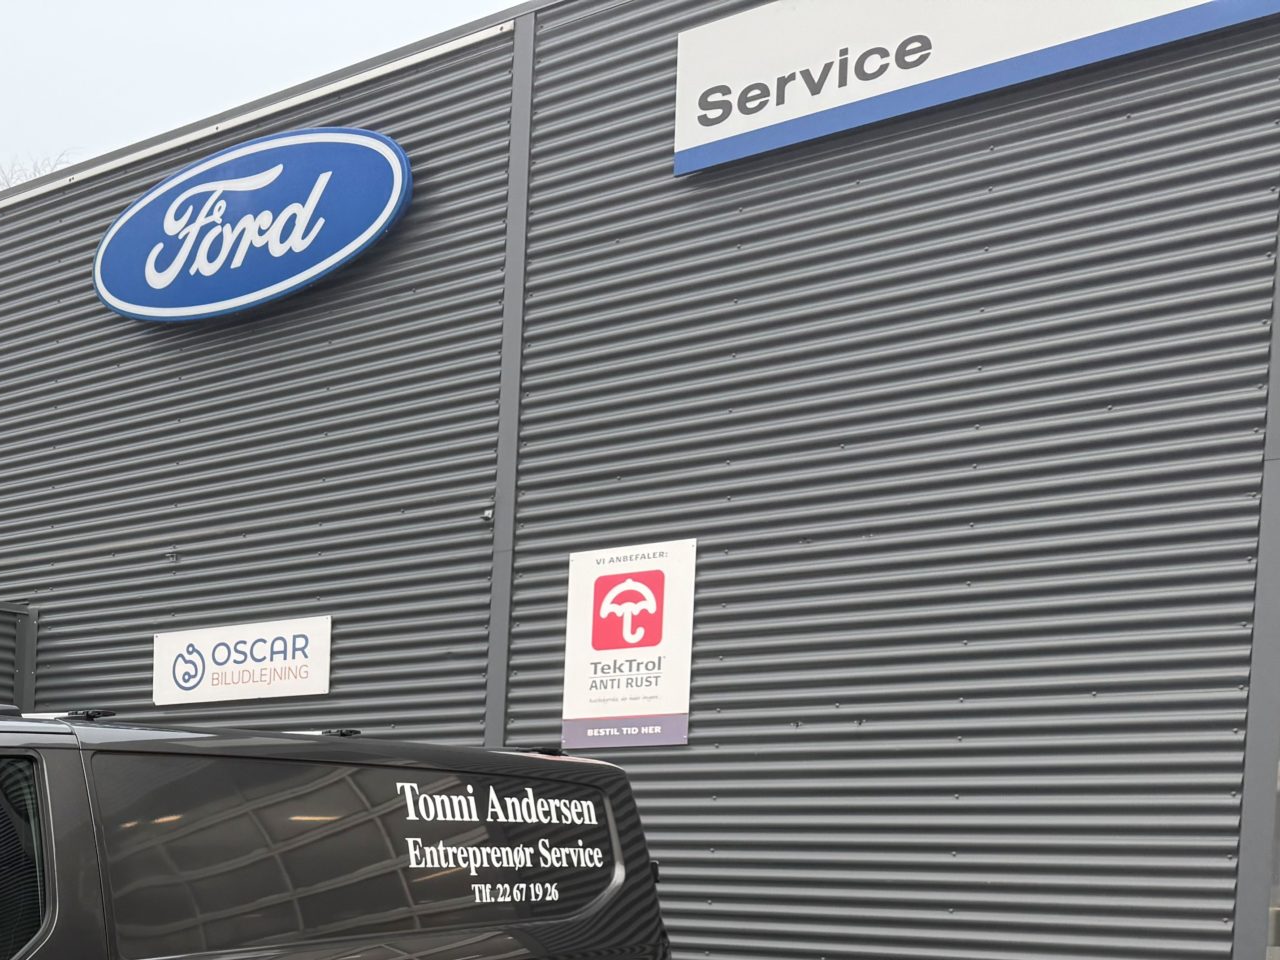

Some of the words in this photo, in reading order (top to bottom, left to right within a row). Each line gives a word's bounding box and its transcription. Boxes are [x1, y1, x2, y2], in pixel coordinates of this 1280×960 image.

[696, 33, 933, 127] Service
[144, 164, 332, 289] Ford
[595, 558, 605, 566] VI
[608, 551, 668, 564] ANBEFALER:
[211, 633, 309, 666] OSCAR
[211, 664, 309, 686] BILUDLEJNING
[590, 656, 662, 675] TekTrol
[589, 677, 620, 691] ANTI
[625, 675, 661, 689] RUST
[587, 727, 619, 736] BESTIL
[622, 727, 638, 735] TID
[641, 726, 661, 734] HER
[396, 782, 479, 822] Tonni
[486, 785, 598, 825] Andersen
[405, 837, 534, 876] Entreprenør
[538, 838, 603, 868] Service
[471, 883, 495, 903] Tlf.
[496, 884, 511, 902] 22
[513, 883, 526, 902] 67
[529, 883, 543, 901] 19
[544, 882, 559, 901] 26
